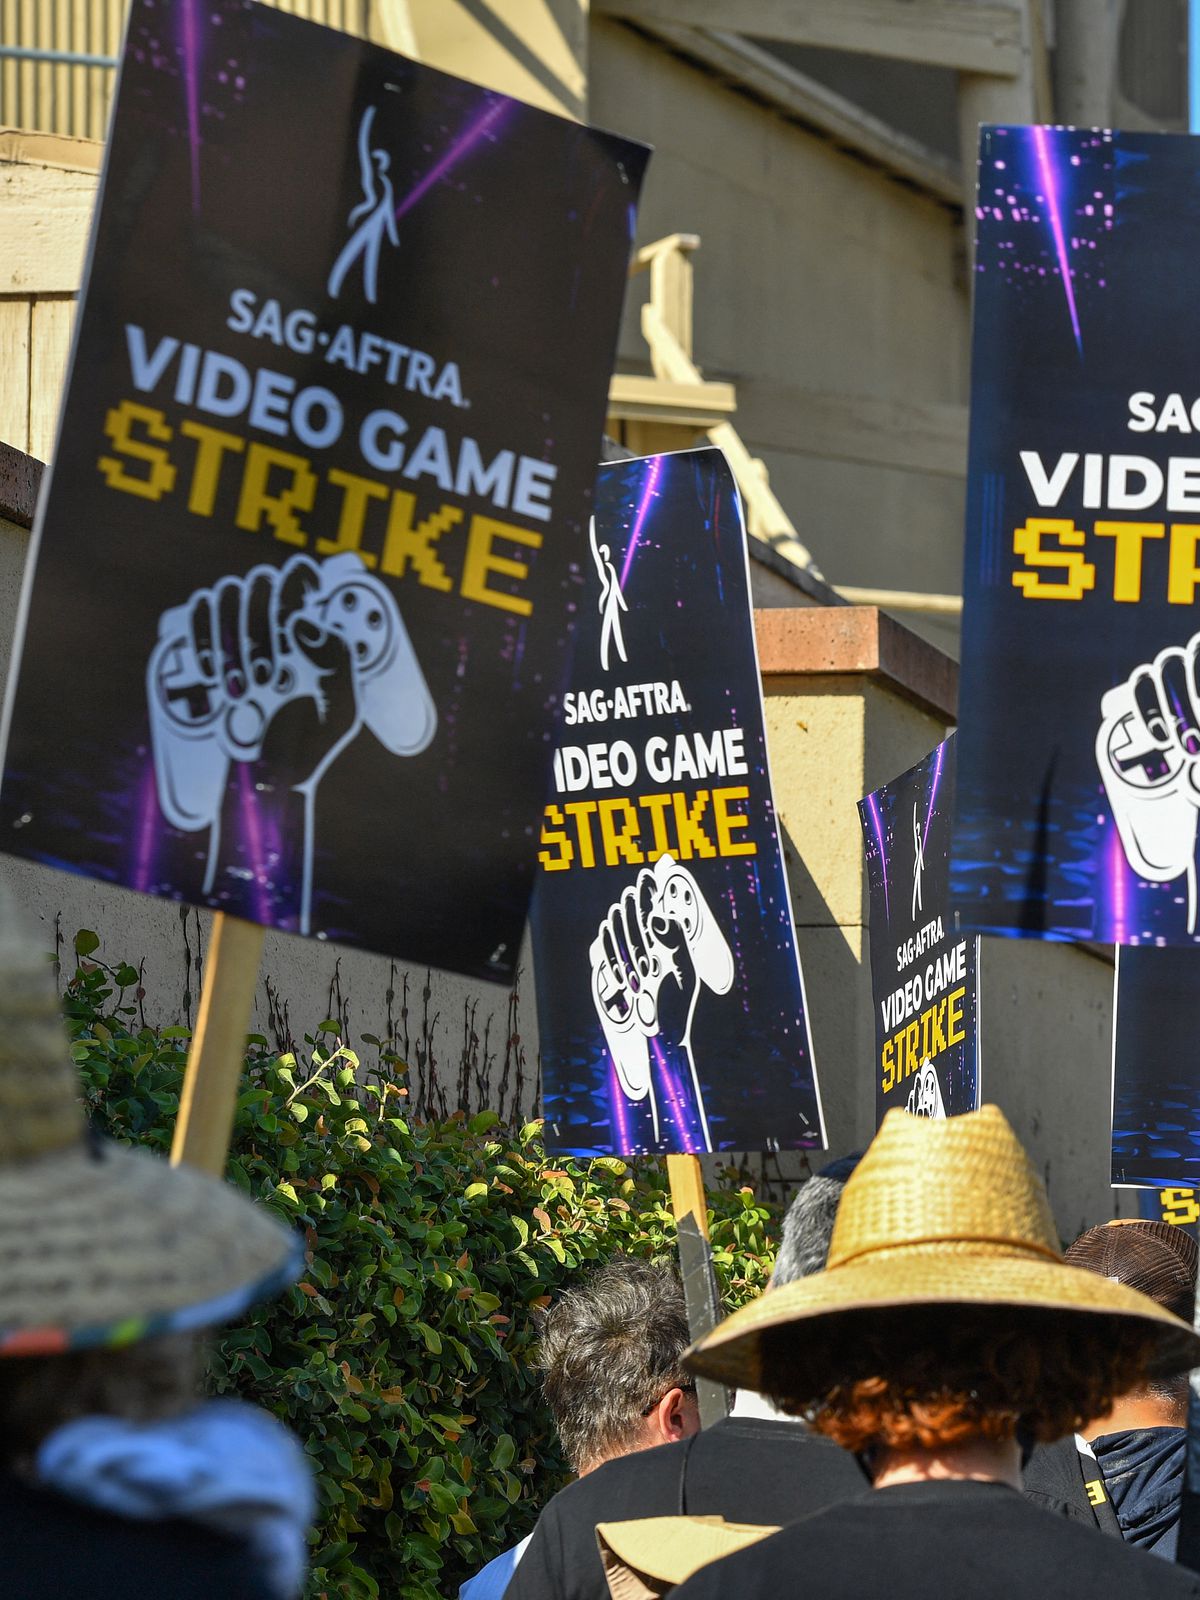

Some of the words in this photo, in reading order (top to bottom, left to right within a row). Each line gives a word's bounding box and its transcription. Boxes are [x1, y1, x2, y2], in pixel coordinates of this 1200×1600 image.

[125, 324, 344, 449] VIDEO
[359, 409, 558, 522] GAME
[98, 399, 543, 617] STRIKE
[553, 740, 638, 792] IDEO
[645, 728, 749, 783] GAME
[538, 786, 757, 871] STRIKE
[881, 974, 923, 1033] VIDEO
[925, 941, 967, 1001] GAME
[882, 986, 966, 1094] STRIKE
